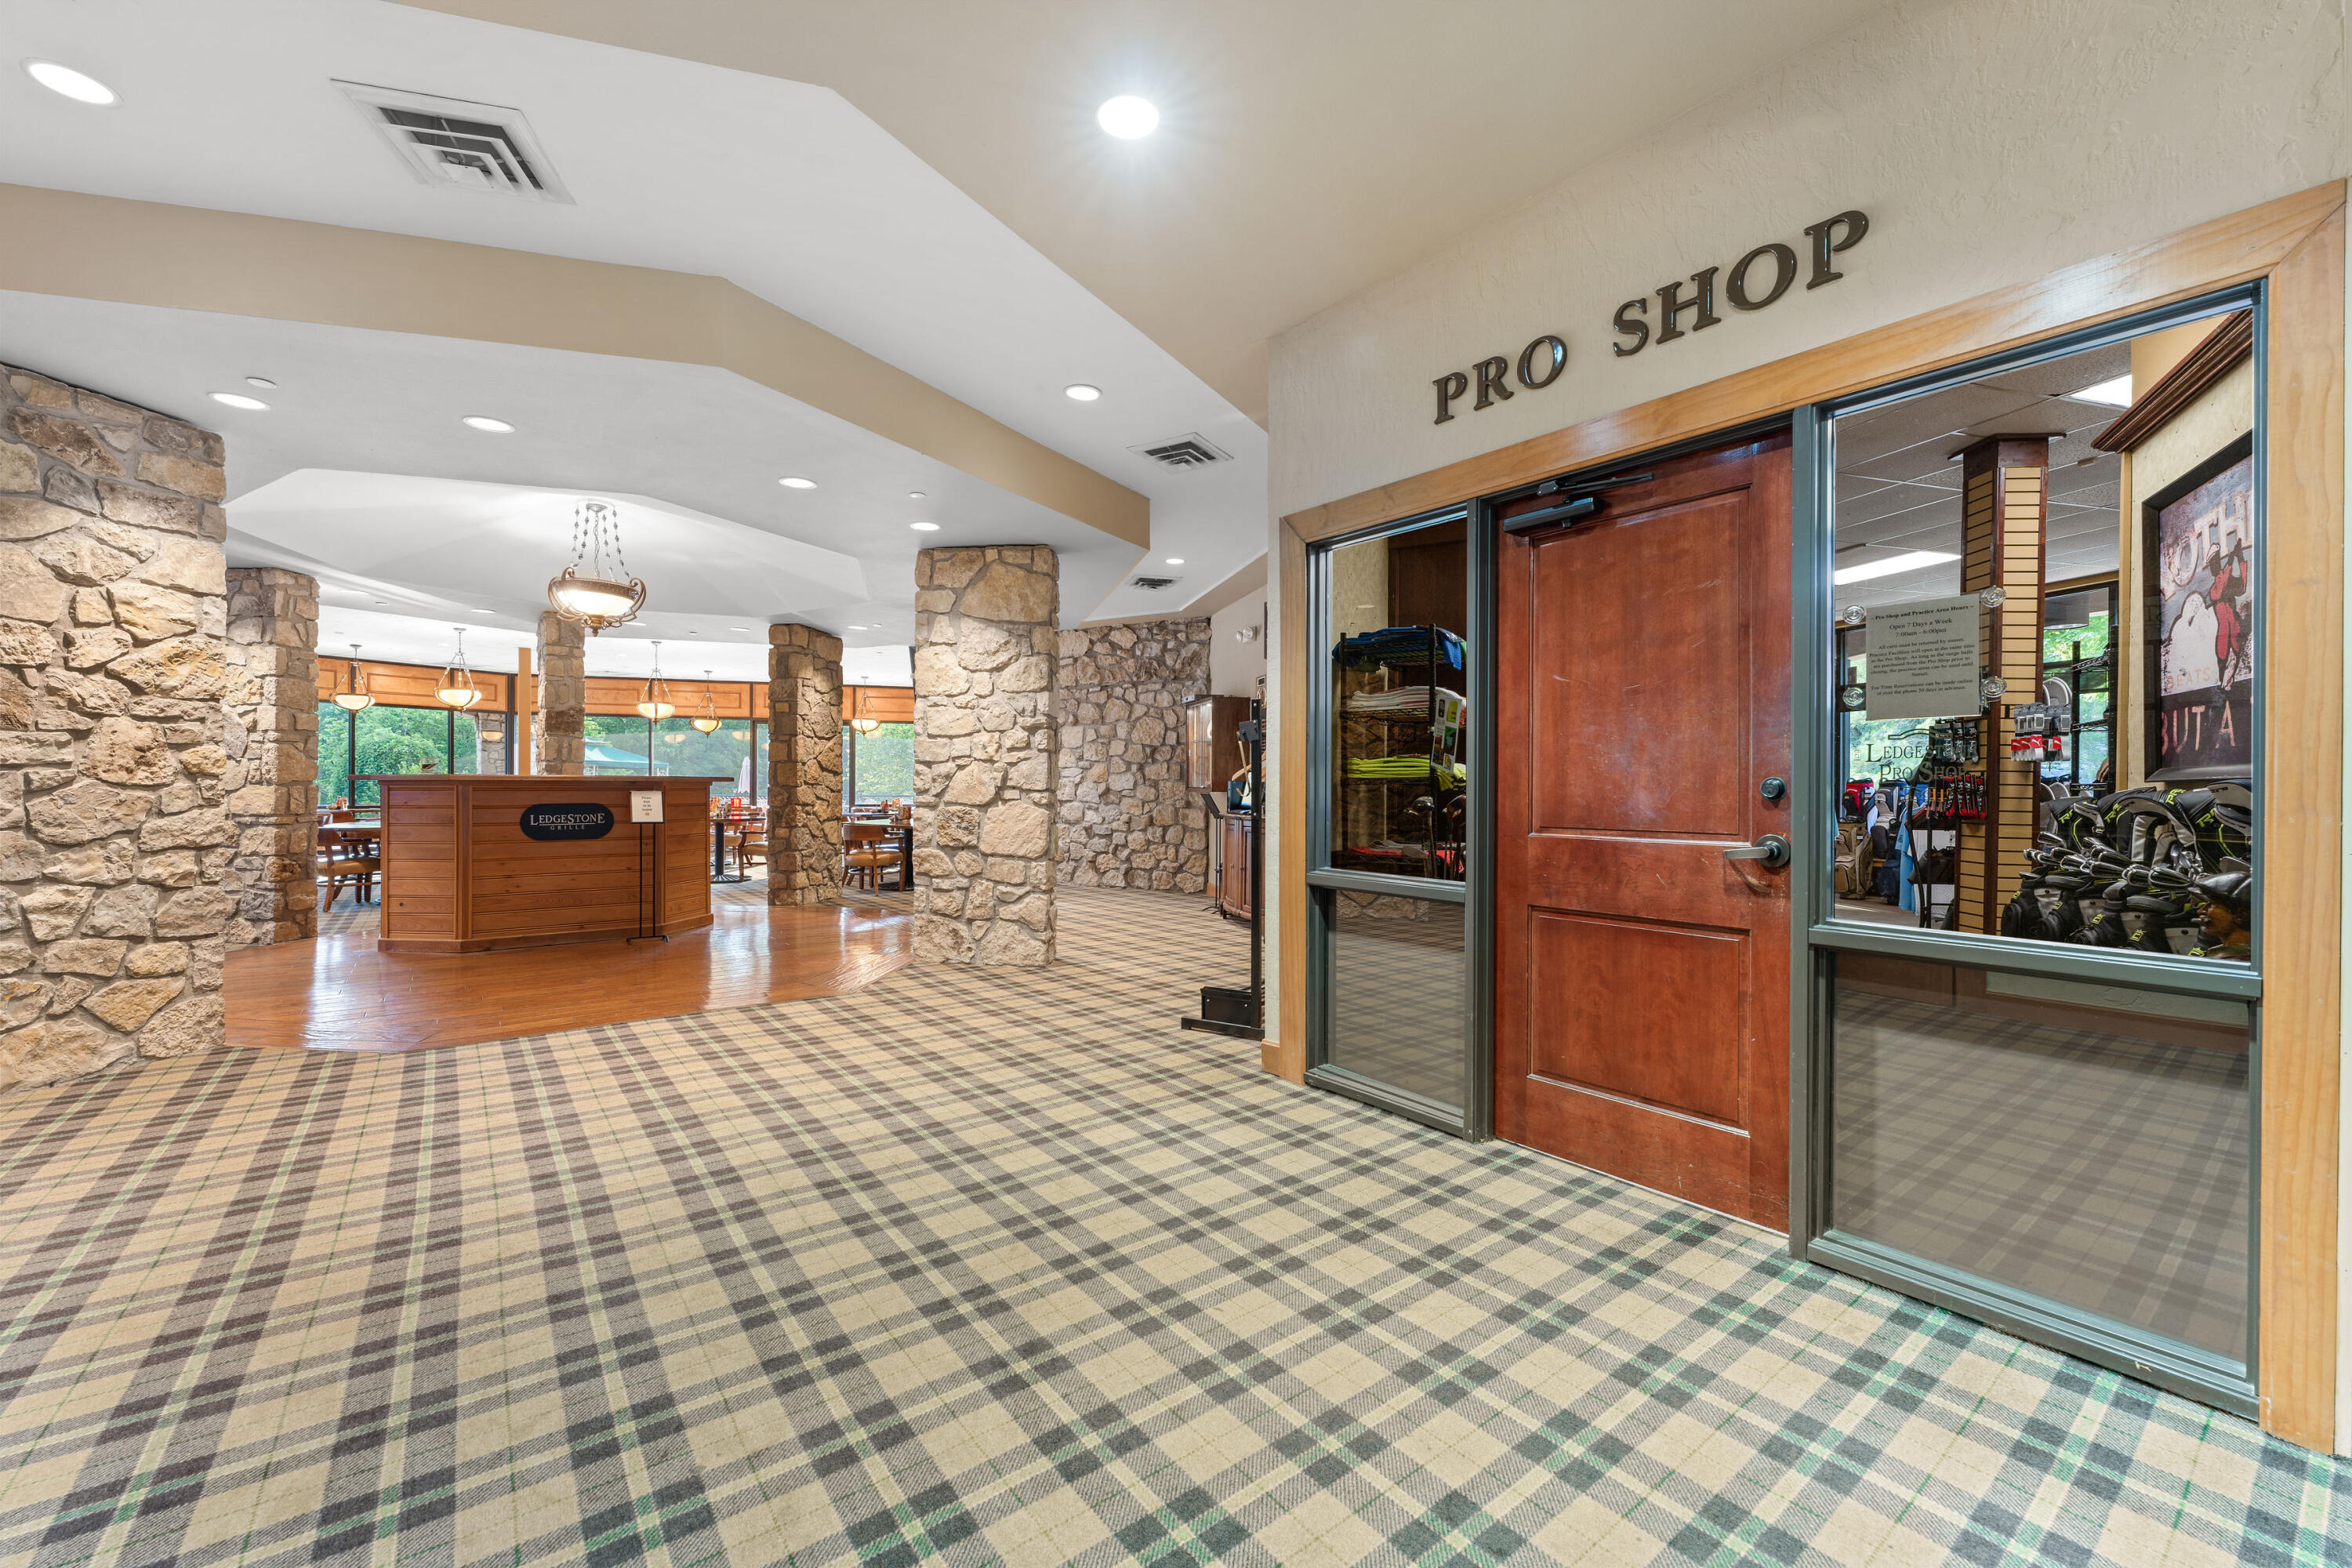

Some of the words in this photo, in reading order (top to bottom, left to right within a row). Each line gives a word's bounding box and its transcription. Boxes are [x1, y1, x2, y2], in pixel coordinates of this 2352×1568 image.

[1432, 335, 1567, 425] PRO
[1612, 209, 1870, 358] SHOP
[2161, 488, 2252, 601] OTH
[2166, 666, 2211, 690] BEATS
[2215, 699, 2235, 749] A
[1878, 764, 1913, 783] PRO
[530, 813, 605, 826] LEDGESTONE
